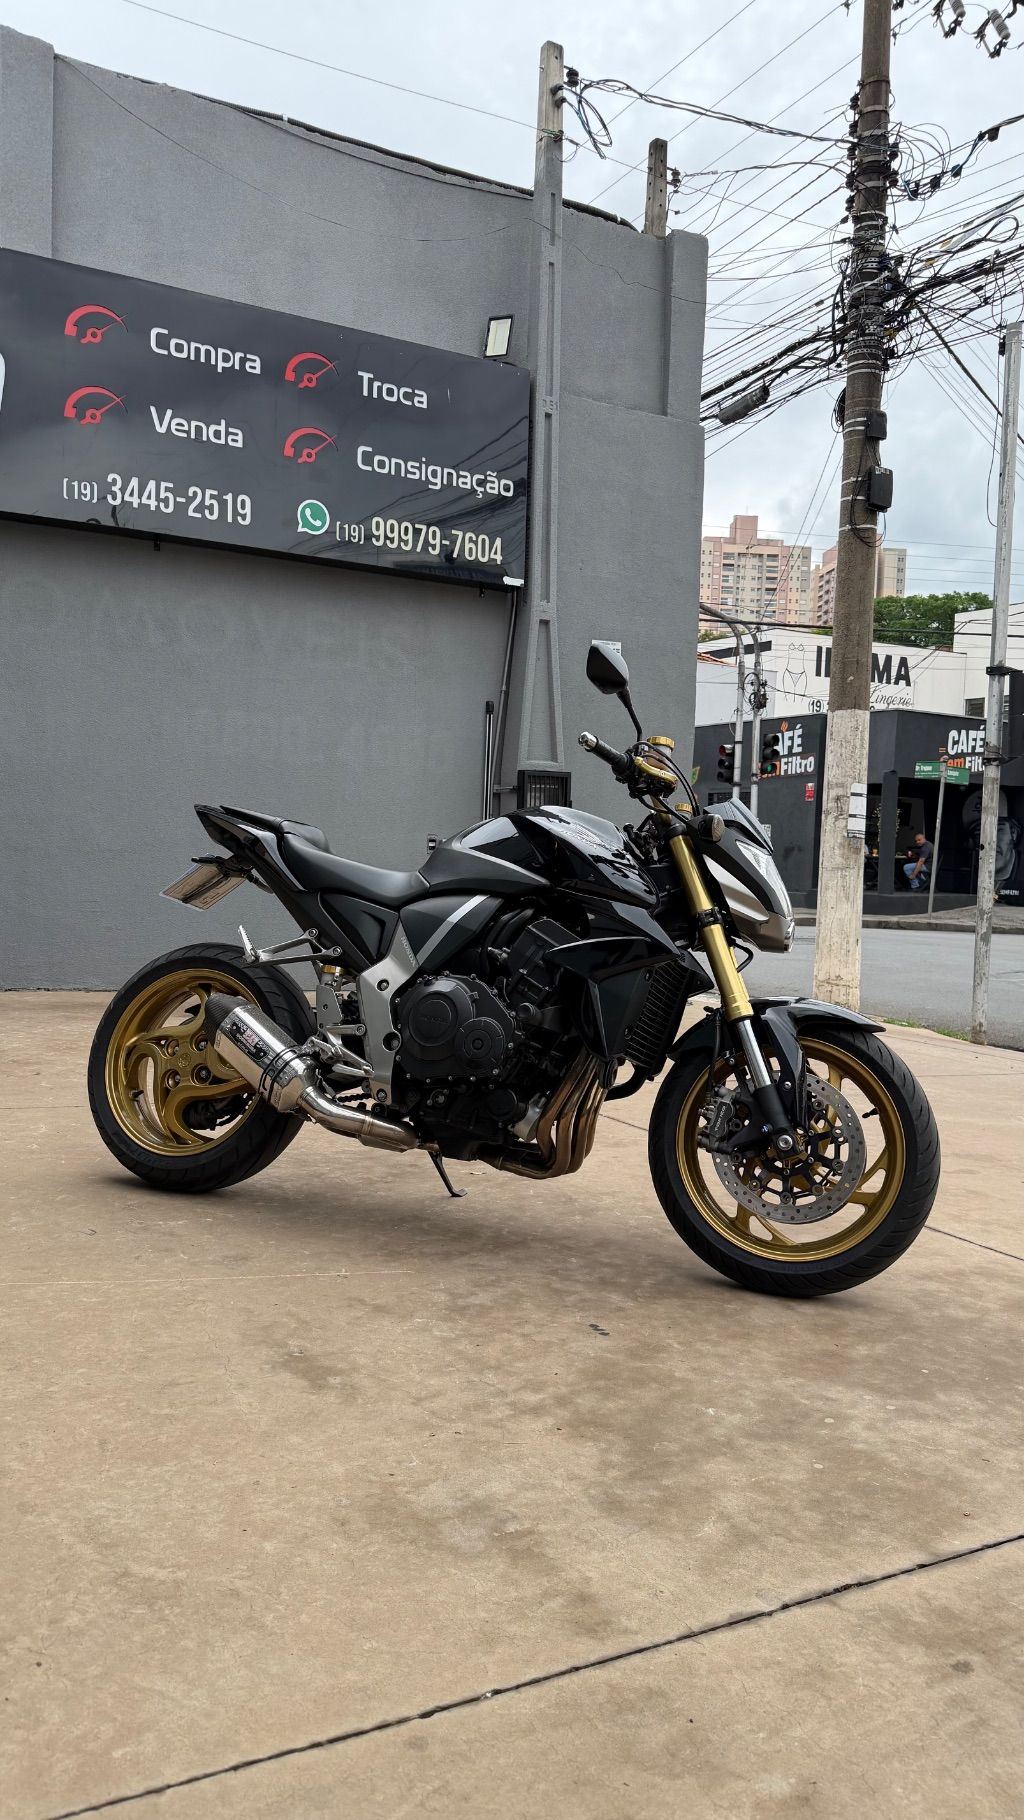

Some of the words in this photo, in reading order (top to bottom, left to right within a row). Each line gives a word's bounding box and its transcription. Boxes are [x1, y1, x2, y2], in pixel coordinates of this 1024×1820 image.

[150, 327, 261, 375] Compra
[357, 371, 428, 409] Troca
[149, 405, 244, 448] Venda
[356, 445, 515, 499] Consignação
[106, 473, 252, 526] 3445-2519
[371, 516, 503, 565] 99979-7604
[947, 725, 986, 756] CAFÉ
[400, 936, 416, 968] HONDA
